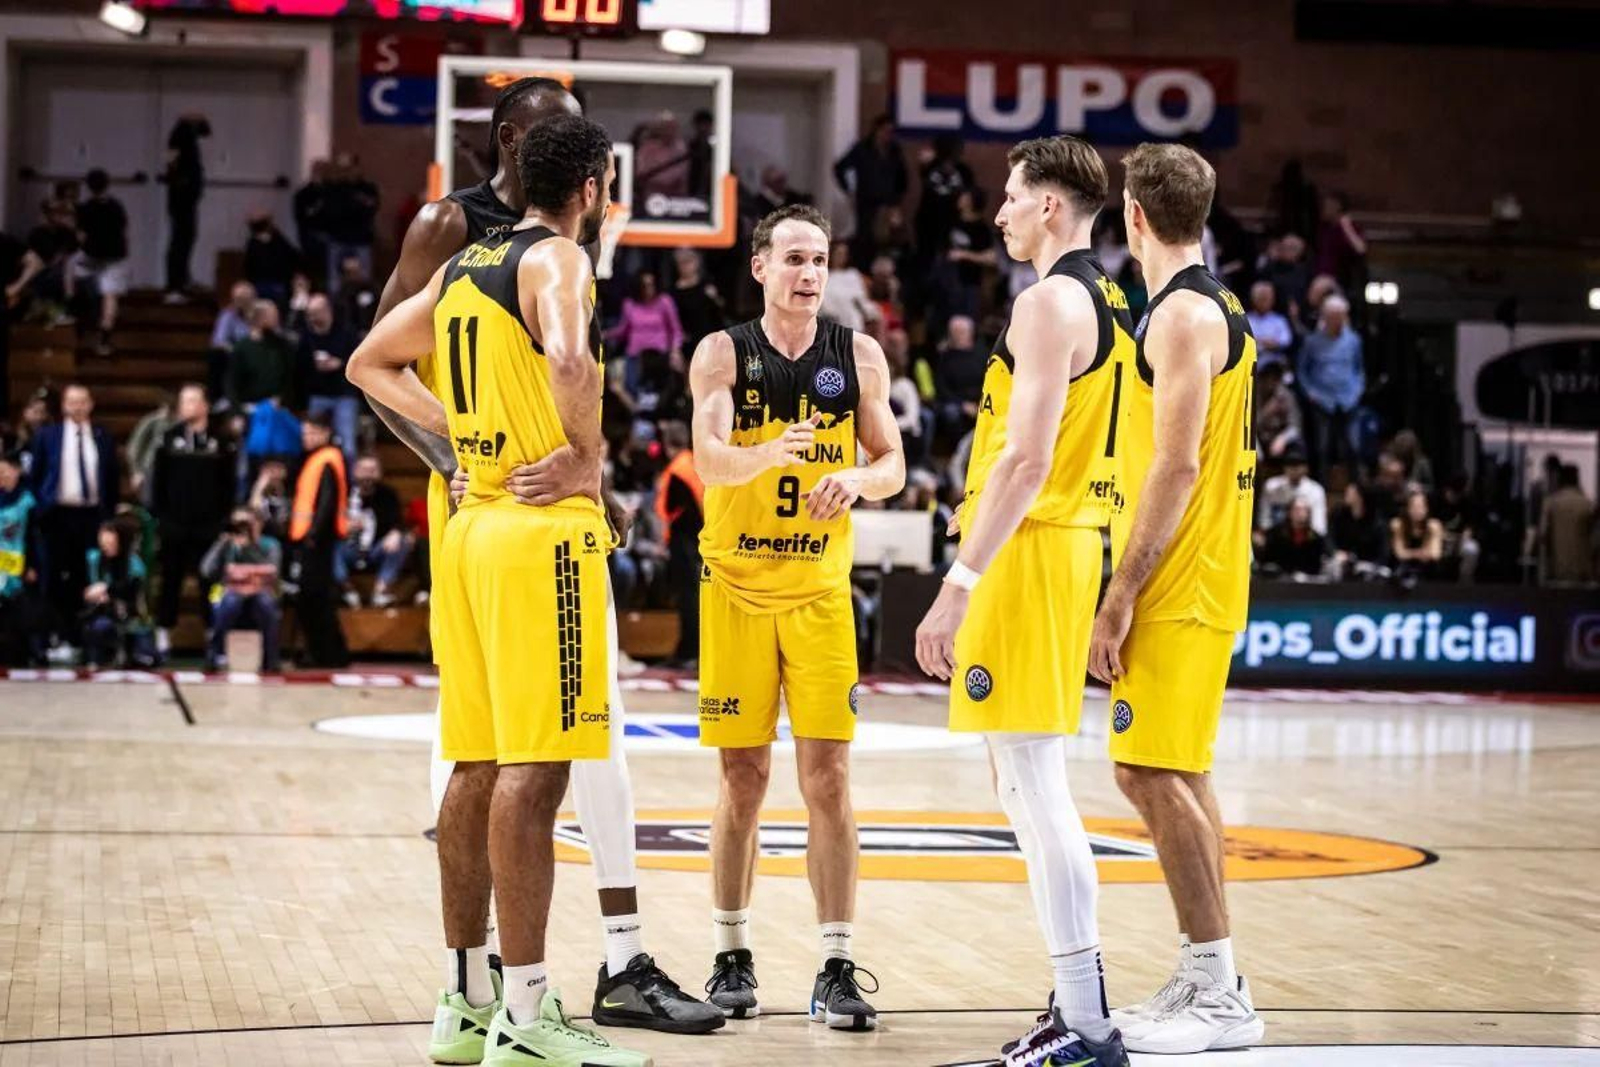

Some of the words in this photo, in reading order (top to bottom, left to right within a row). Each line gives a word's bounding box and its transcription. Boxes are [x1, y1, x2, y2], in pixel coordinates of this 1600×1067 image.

[369, 76, 399, 116] C
[896, 58, 1216, 137] LUPO
[447, 316, 479, 415] 11
[776, 475, 799, 518] 9
[738, 533, 829, 556] tenerife!
